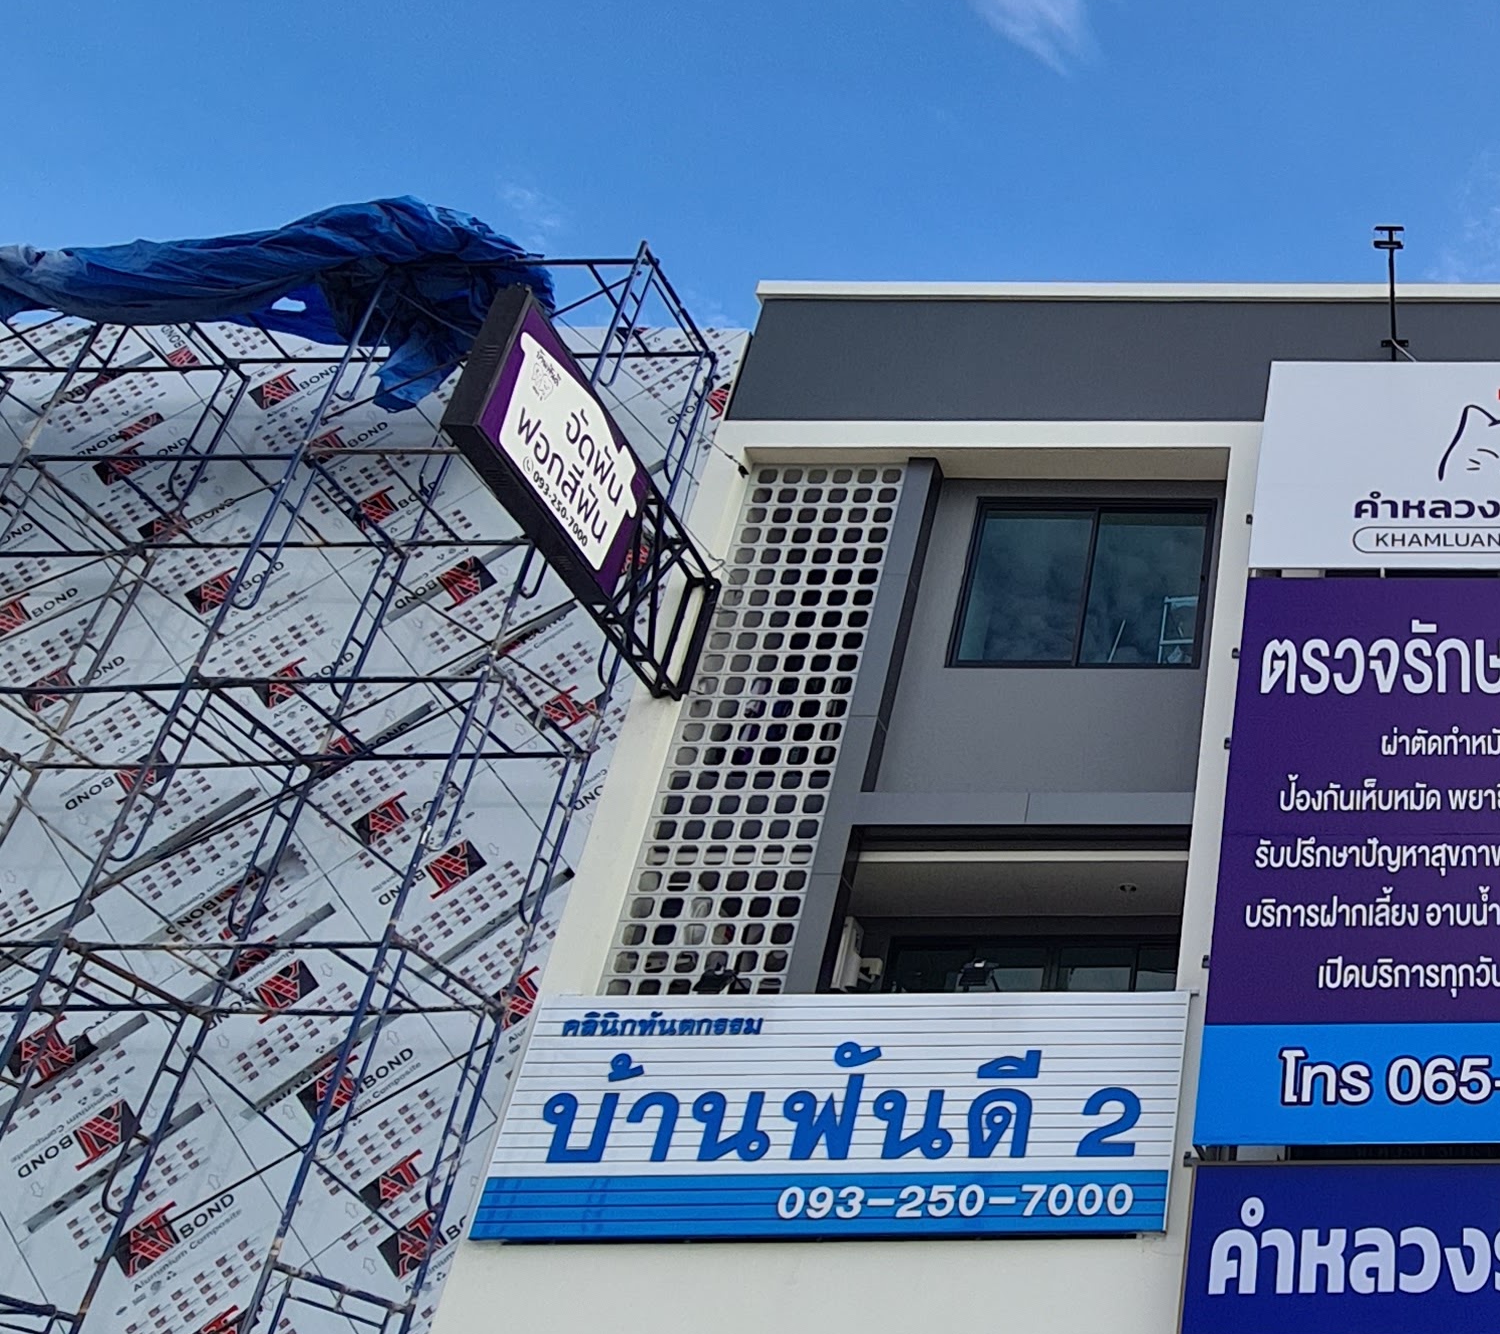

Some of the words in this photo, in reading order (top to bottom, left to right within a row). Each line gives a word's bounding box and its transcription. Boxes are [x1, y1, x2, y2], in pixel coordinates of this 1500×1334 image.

[299, 365, 339, 390] BOND
[347, 421, 388, 448] BOND
[517, 407, 607, 543] ฟอกสีฟัน
[565, 409, 623, 506] จัดฟัน
[533, 471, 588, 547] 093-250-7000
[239, 561, 285, 591] BOND
[395, 581, 438, 609] BOND
[32, 587, 78, 617] BOND
[64, 777, 115, 810] BOND
[1279, 774, 1441, 811] ป้องกันเห็บหมัด
[1245, 886, 1419, 928] บริการฝากเลี้ยง
[1425, 885, 1500, 927] อาบน้ำ
[562, 1011, 763, 1038] คลินิกทันตกรรม
[362, 1048, 413, 1089] BOND
[1278, 1049, 1371, 1105] โทร
[542, 1041, 1042, 1163] บ้านฟันดี
[1076, 1087, 1142, 1157] 2
[18, 1134, 73, 1178] BOND
[179, 1193, 234, 1239] BOND
[776, 1182, 1134, 1220] 093-250-7000
